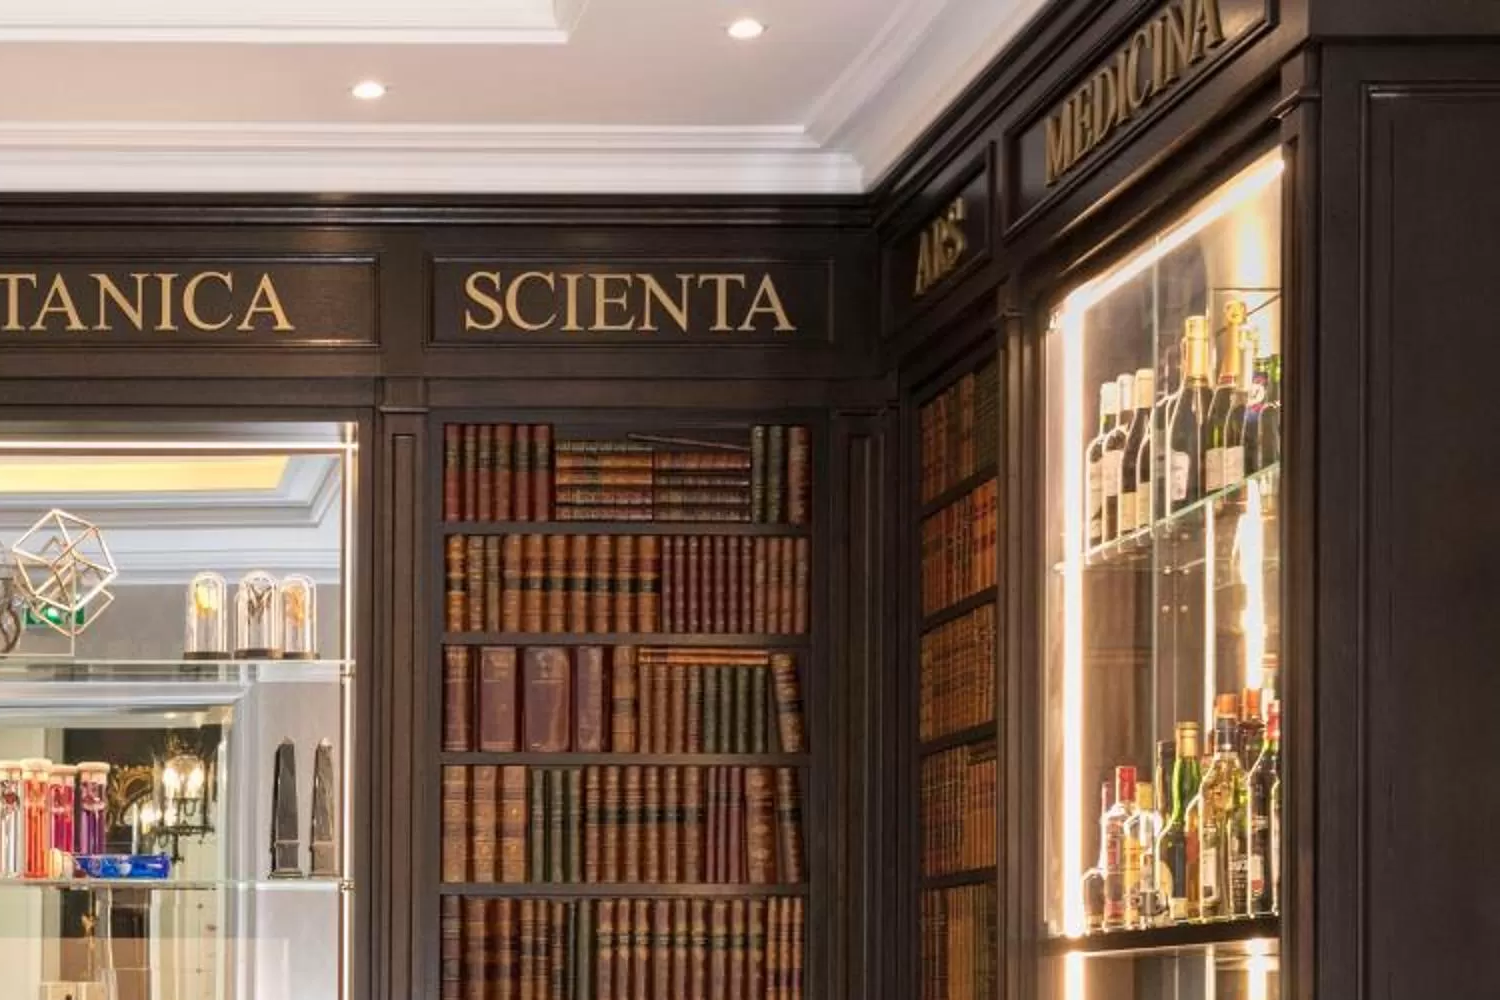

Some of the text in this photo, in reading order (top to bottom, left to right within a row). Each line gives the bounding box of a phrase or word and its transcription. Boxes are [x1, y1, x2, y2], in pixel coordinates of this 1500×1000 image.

[1044, 0, 1226, 188] MEDICINA
[912, 197, 967, 296] ARS
[465, 271, 796, 332] SCIENTA
